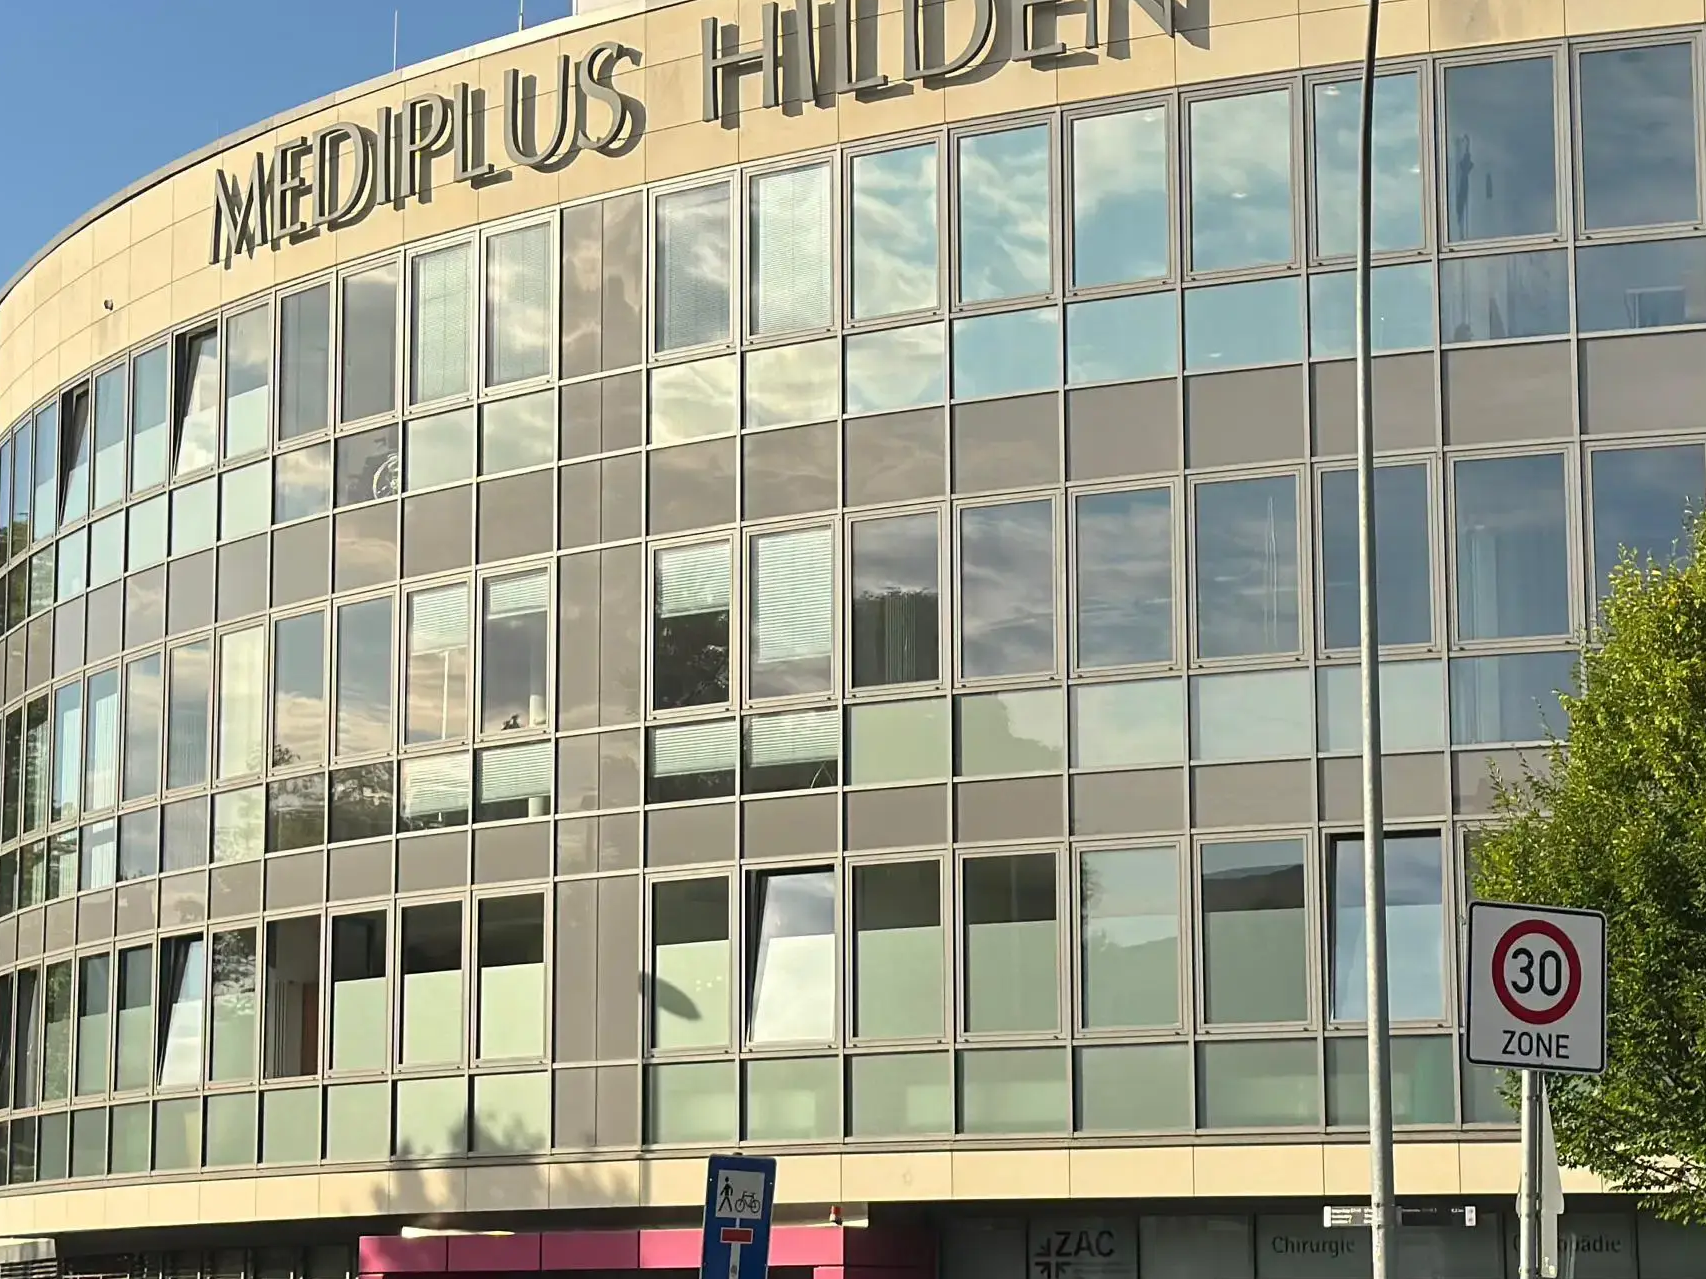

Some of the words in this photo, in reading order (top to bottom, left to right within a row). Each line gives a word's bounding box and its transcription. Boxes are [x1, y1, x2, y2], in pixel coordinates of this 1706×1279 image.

[208, 41, 628, 265] MEDIPLUS
[1511, 947, 1563, 997] 30
[1501, 1029, 1570, 1060] ZONE
[1055, 1230, 1115, 1257] ZAC
[1271, 1235, 1356, 1259] Chirurgie
